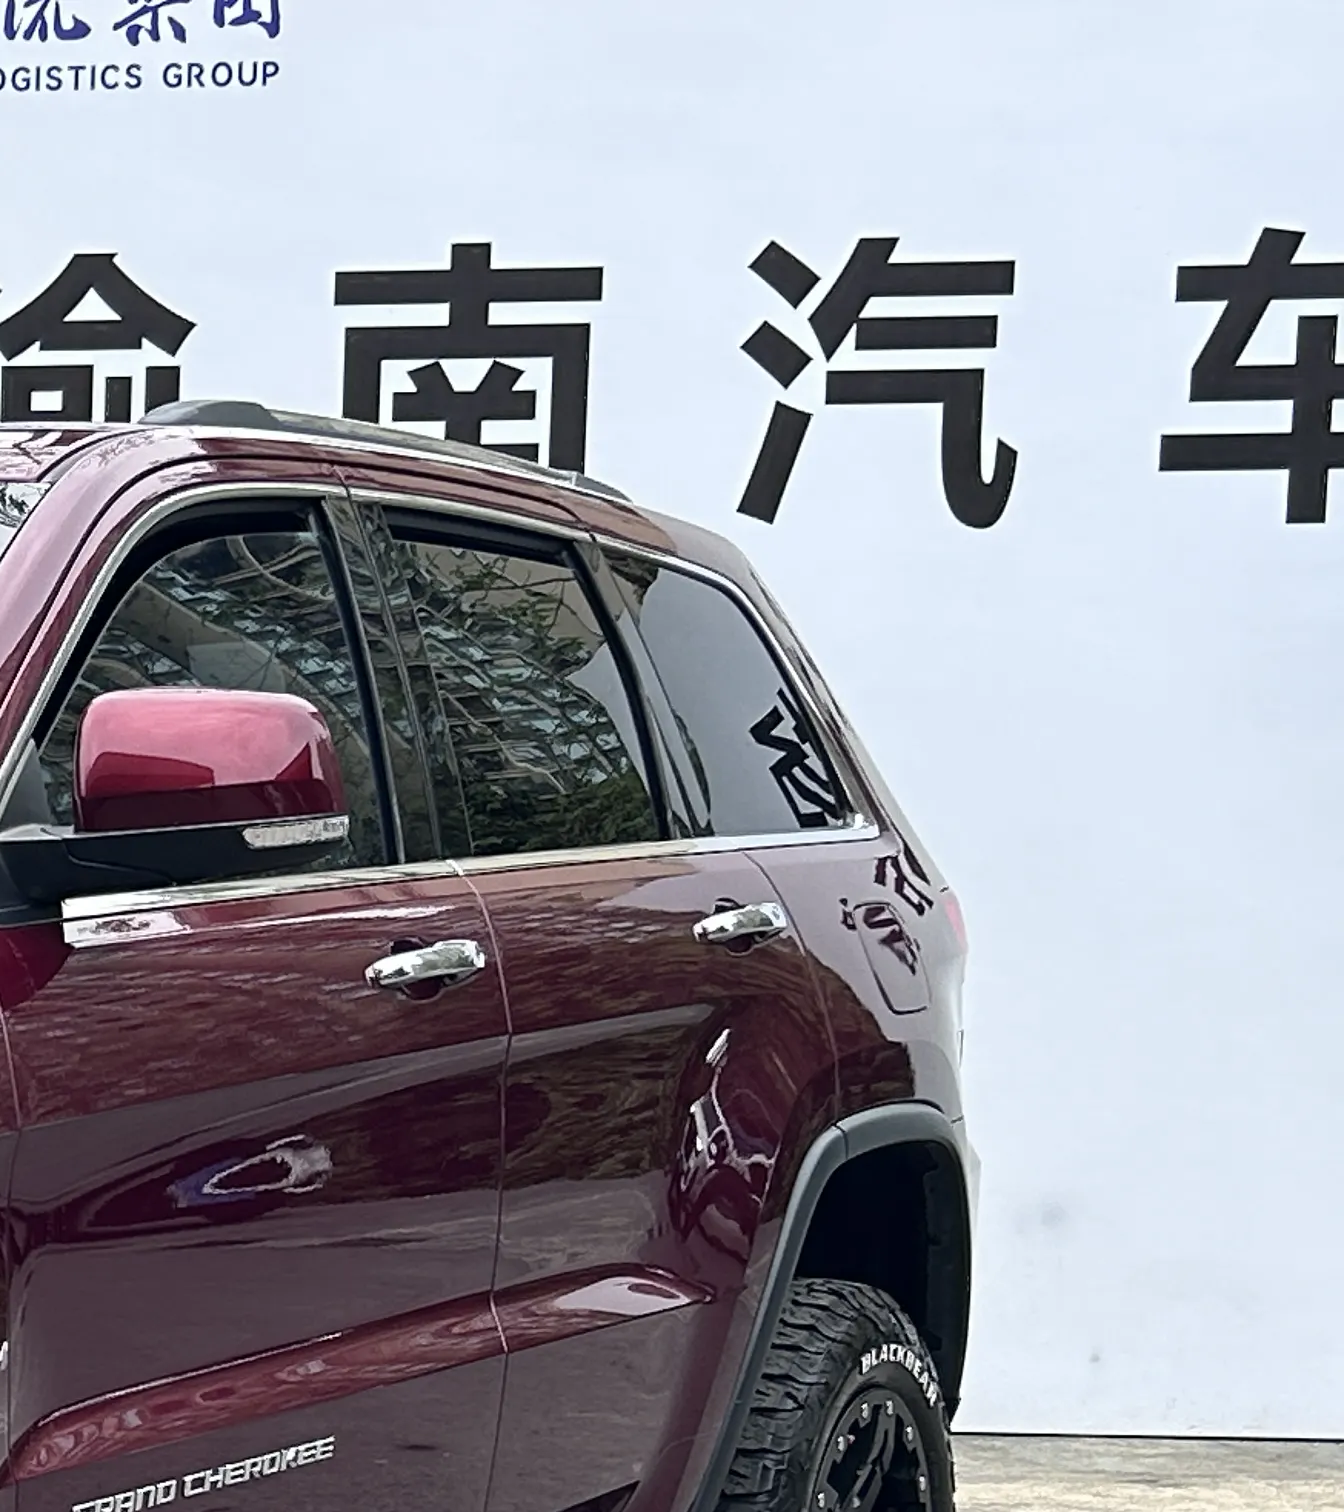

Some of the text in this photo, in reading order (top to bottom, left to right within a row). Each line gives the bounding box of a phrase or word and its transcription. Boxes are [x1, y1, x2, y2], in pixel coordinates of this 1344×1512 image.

[162, 60, 280, 89] GROUP
[860, 1343, 938, 1407] BLACKBEAR
[182, 1435, 336, 1499] CHEROKEE
